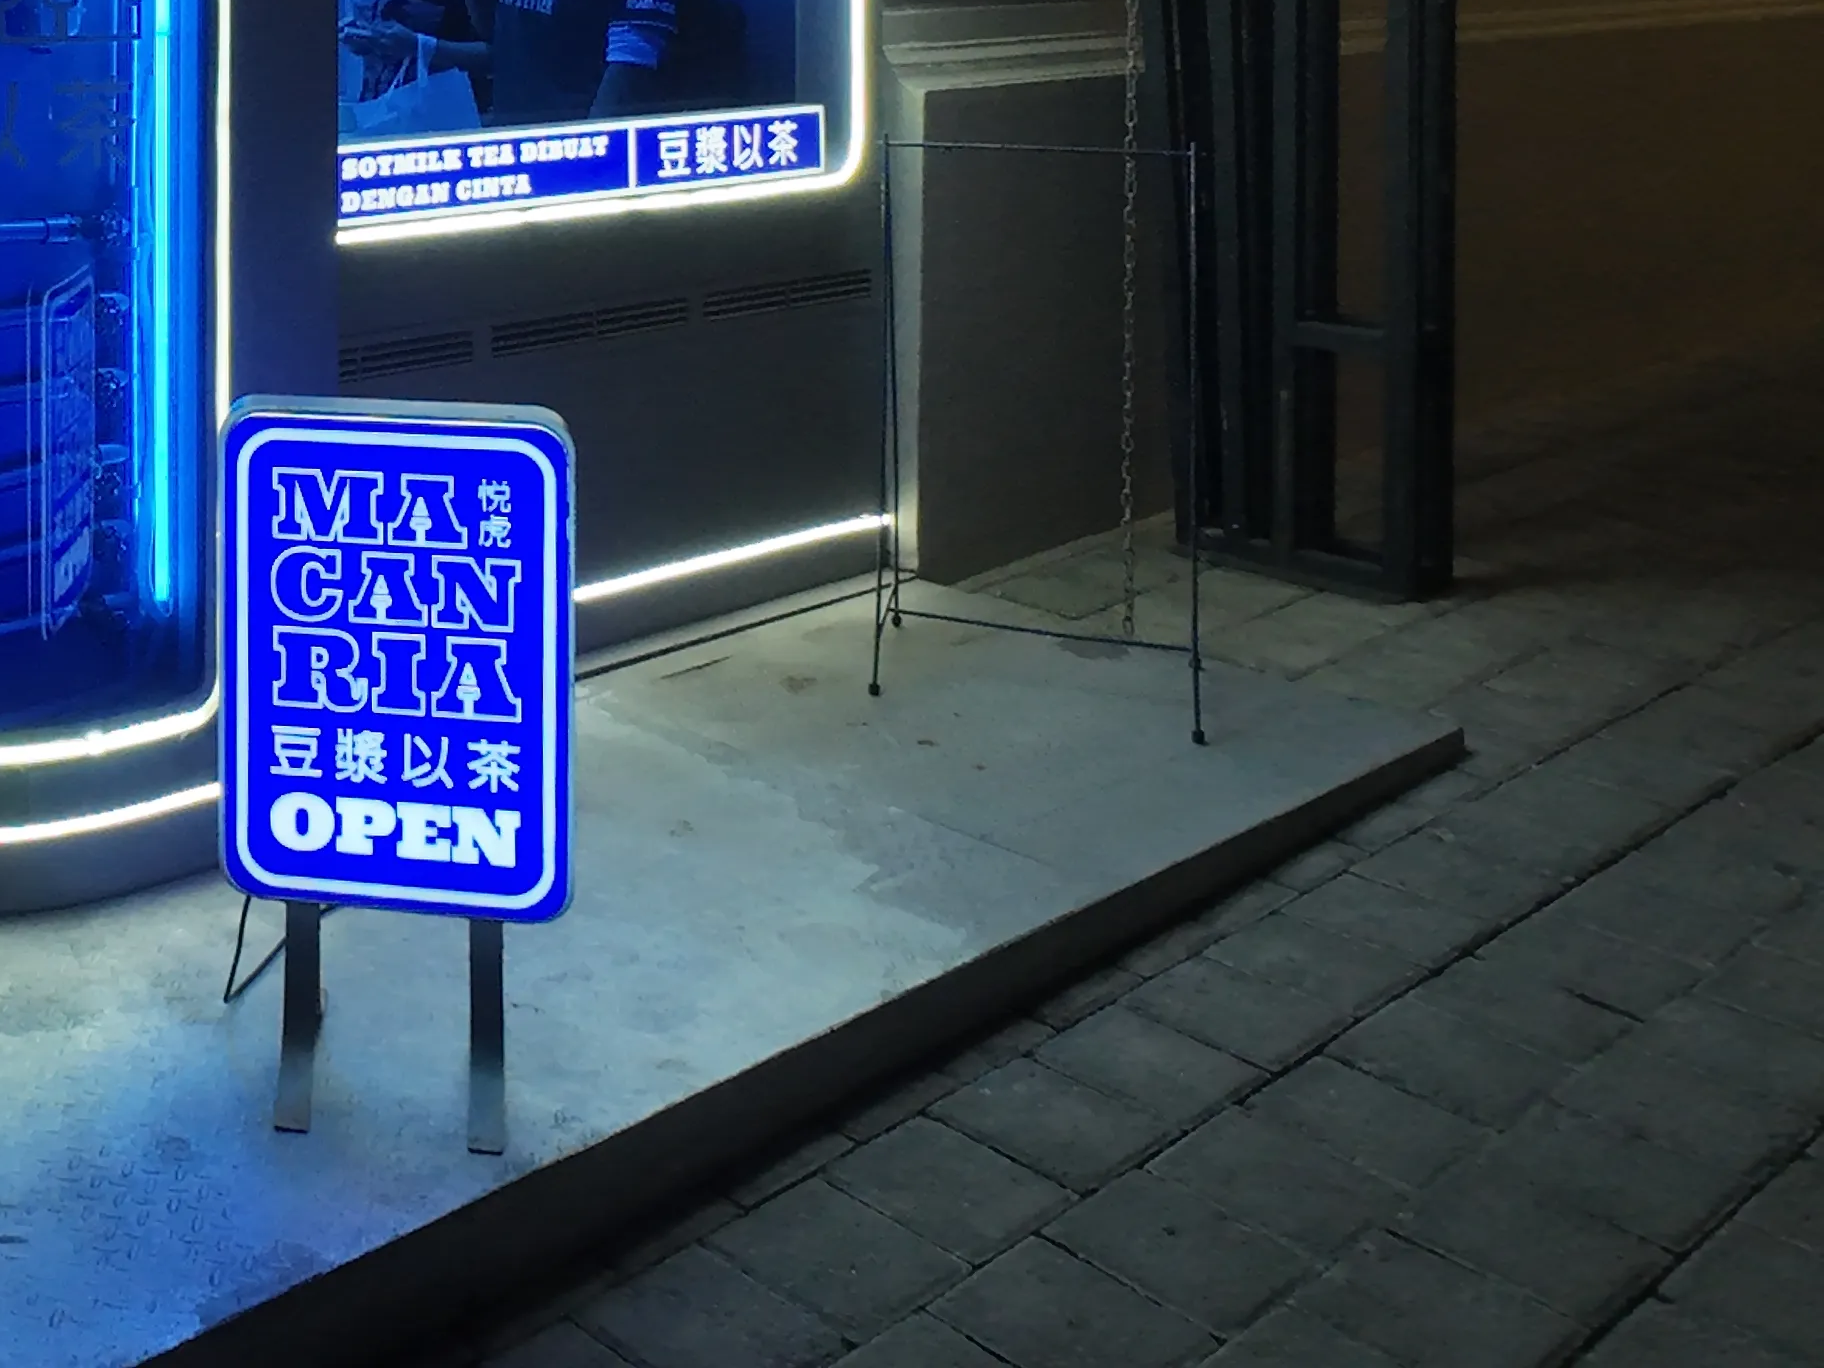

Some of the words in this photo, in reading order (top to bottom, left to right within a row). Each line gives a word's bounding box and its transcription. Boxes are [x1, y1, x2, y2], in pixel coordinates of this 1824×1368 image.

[341, 147, 462, 181] SOYMILK
[467, 142, 515, 169] TEA
[519, 135, 609, 165] DIBUAT
[341, 181, 450, 213] DENGAN
[455, 174, 532, 202] CINTA
[272, 467, 468, 550] MA
[271, 546, 522, 633] CAN
[272, 625, 522, 723] RIA
[270, 792, 522, 869] OPEN
